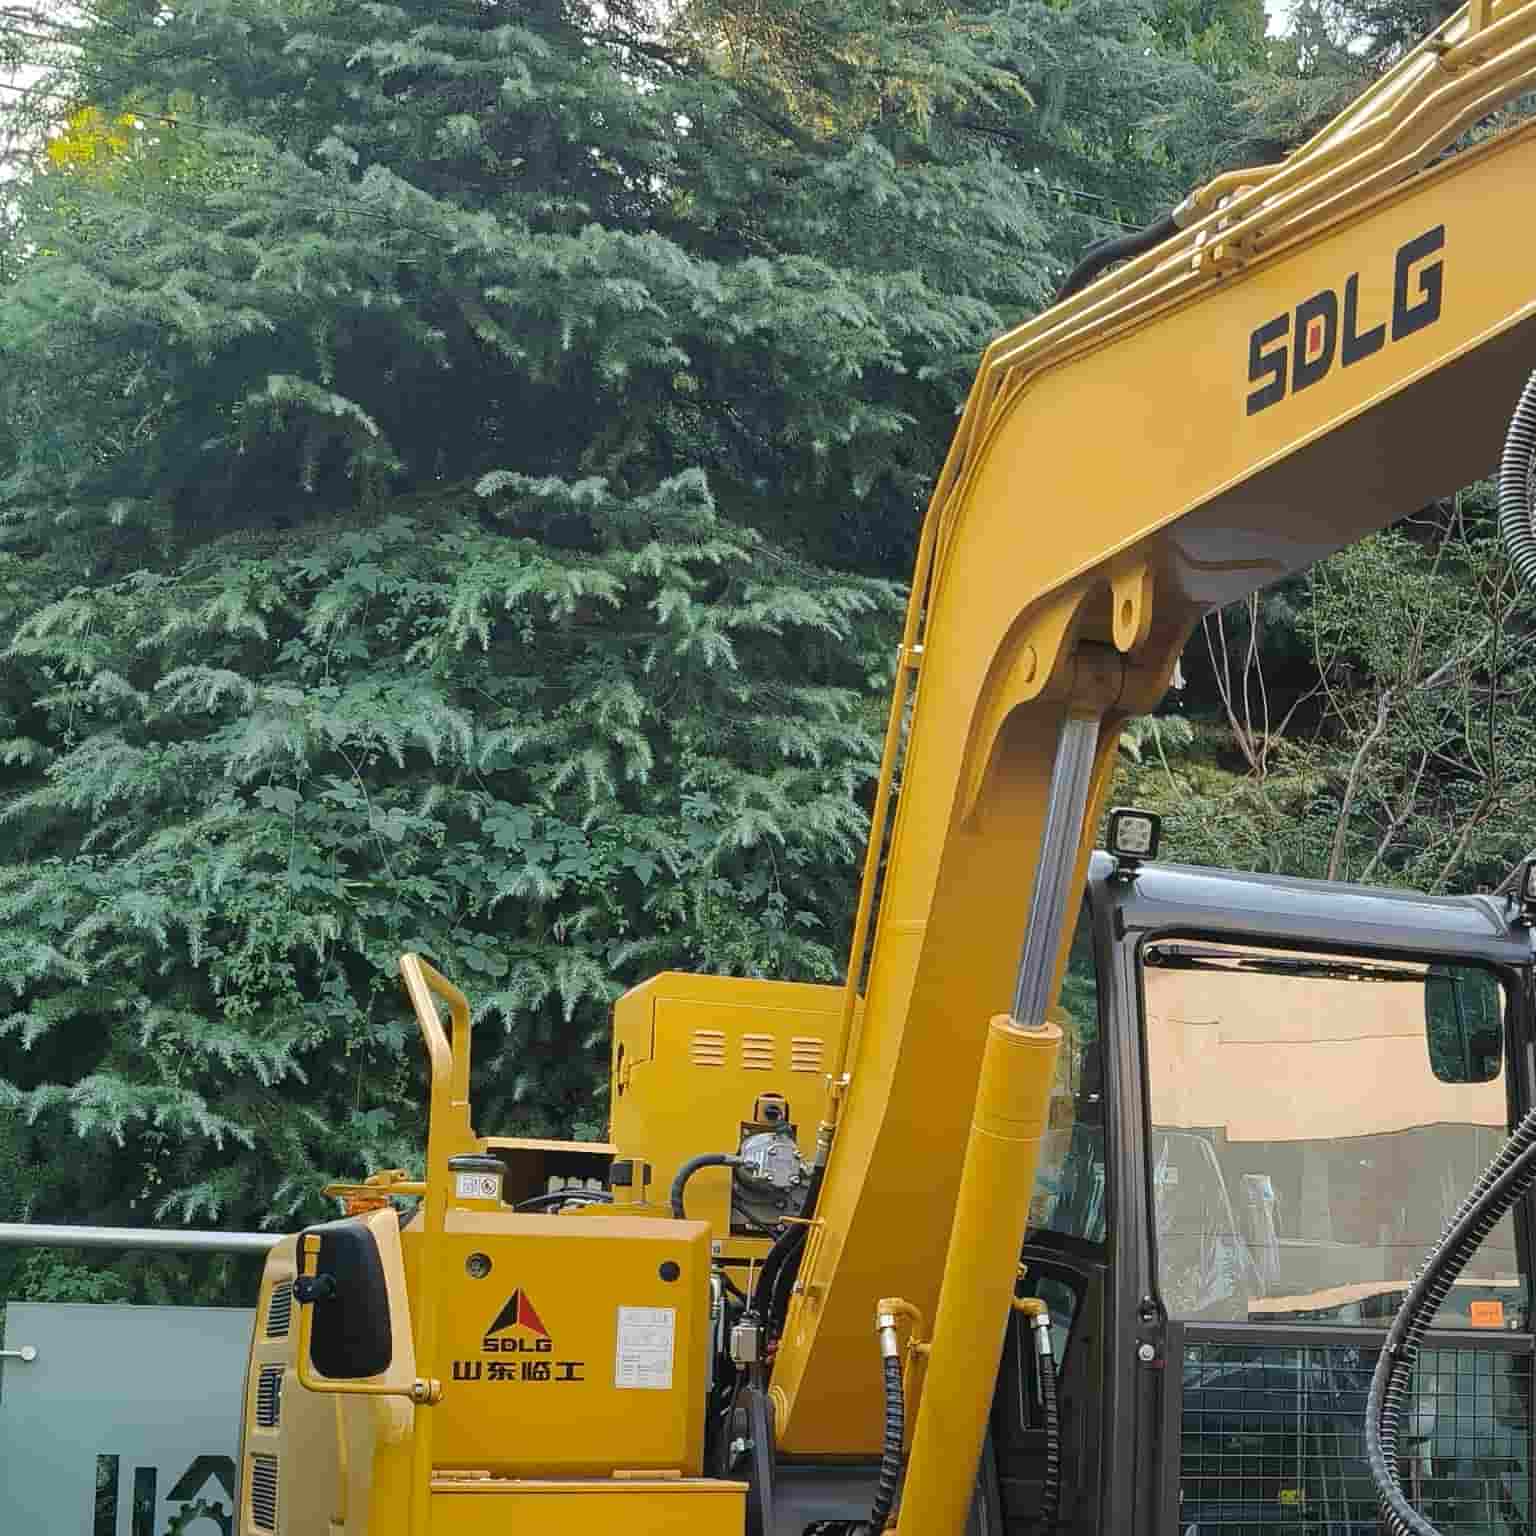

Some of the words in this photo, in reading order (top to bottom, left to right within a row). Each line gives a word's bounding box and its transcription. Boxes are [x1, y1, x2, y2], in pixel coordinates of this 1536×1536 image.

[1246, 224, 1445, 416] SDLG
[482, 1338, 552, 1353] SDLG
[453, 1361, 584, 1381] 山东临工
